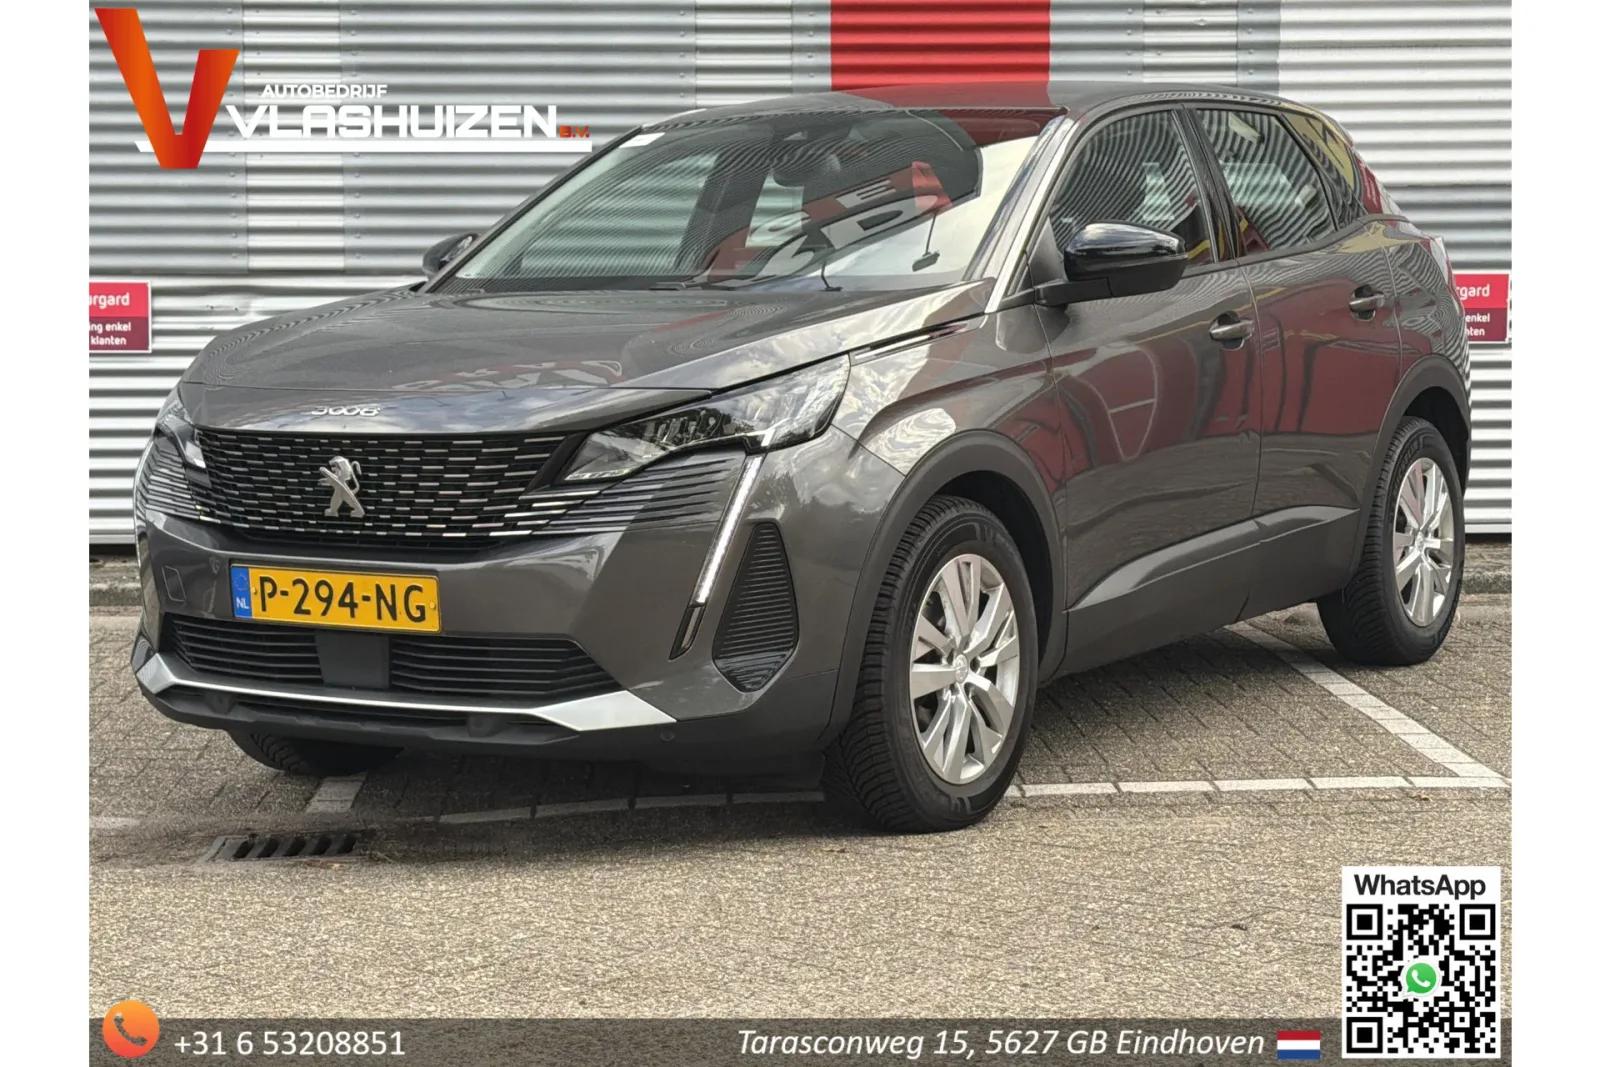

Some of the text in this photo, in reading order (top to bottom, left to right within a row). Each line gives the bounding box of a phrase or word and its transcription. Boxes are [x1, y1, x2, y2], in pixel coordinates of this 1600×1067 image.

[105, 321, 132, 332] enkel
[90, 336, 127, 346] klanten
[236, 597, 250, 609] NL
[259, 576, 426, 623] P-294-NG
